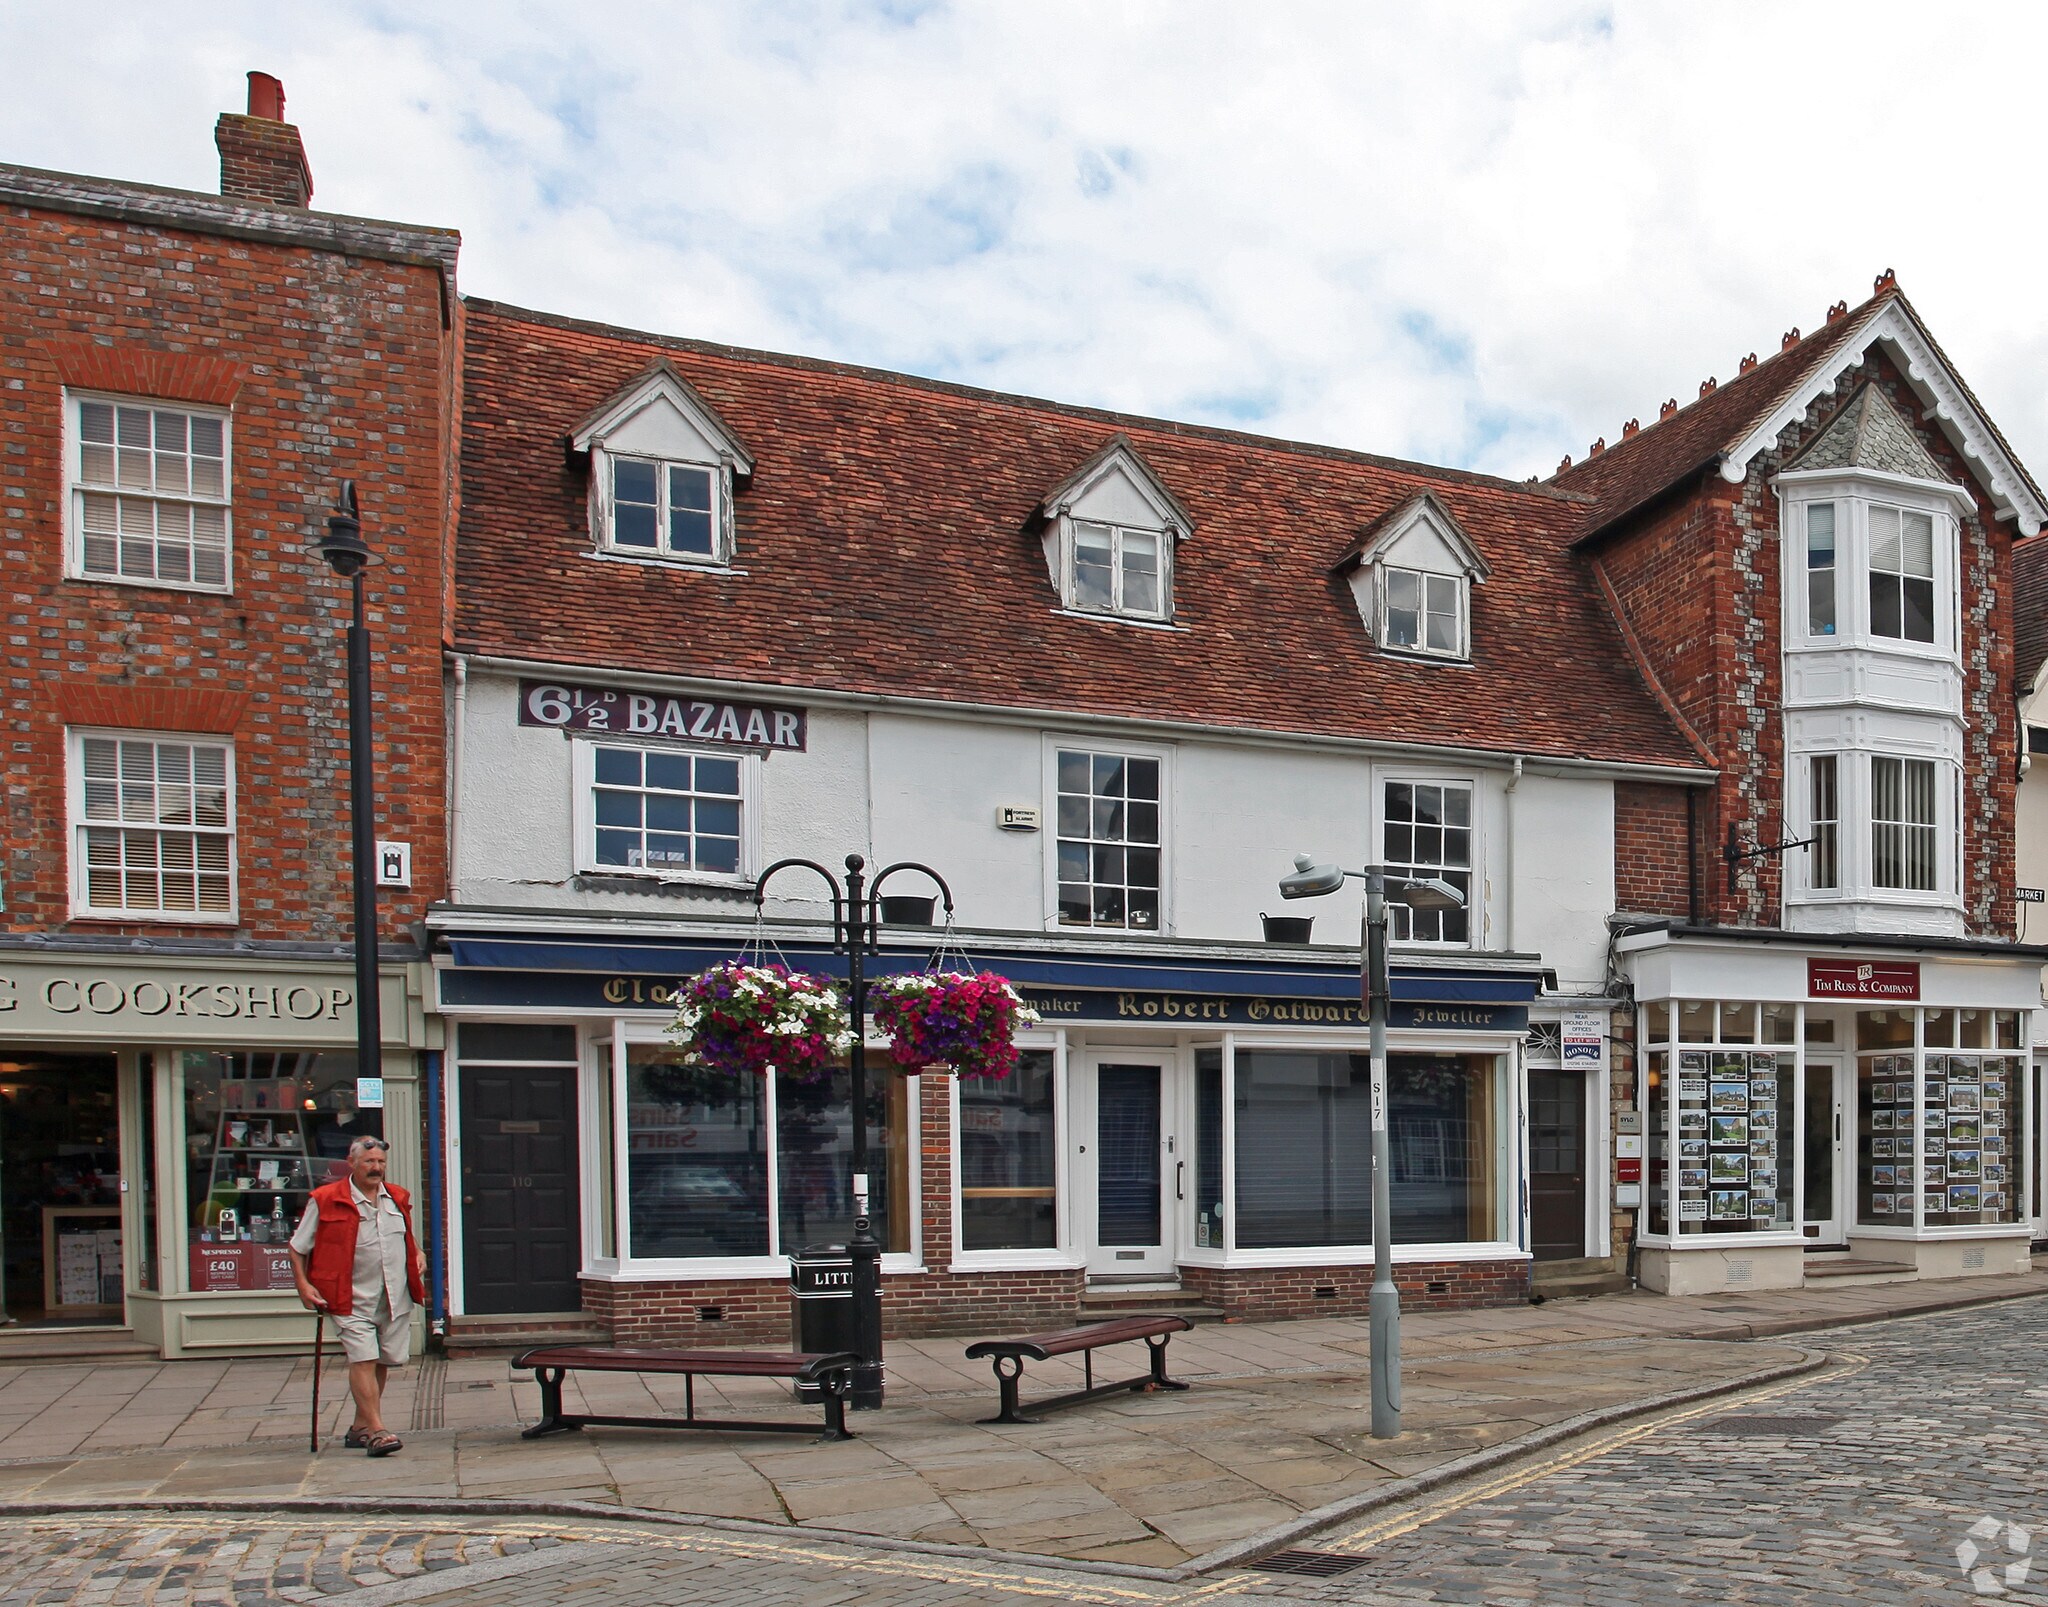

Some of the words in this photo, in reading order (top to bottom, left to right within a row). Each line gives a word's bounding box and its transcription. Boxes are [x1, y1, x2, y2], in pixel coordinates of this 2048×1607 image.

[626, 694, 800, 747] BAZAAR
[2016, 889, 2044, 901] MARKET
[1859, 981, 1869, 992] &
[1871, 981, 1914, 994] COMPANY
[40, 977, 353, 1021] COOKSHOP
[603, 977, 669, 1004] Clo
[1117, 993, 1230, 1019] Robert
[1412, 1007, 1493, 1026] Jeweller
[1565, 1046, 1599, 1058] HONOUR
[201, 1248, 242, 1256] NESPRESSO
[210, 1261, 235, 1271] £40
[814, 1272, 853, 1286] LITT
